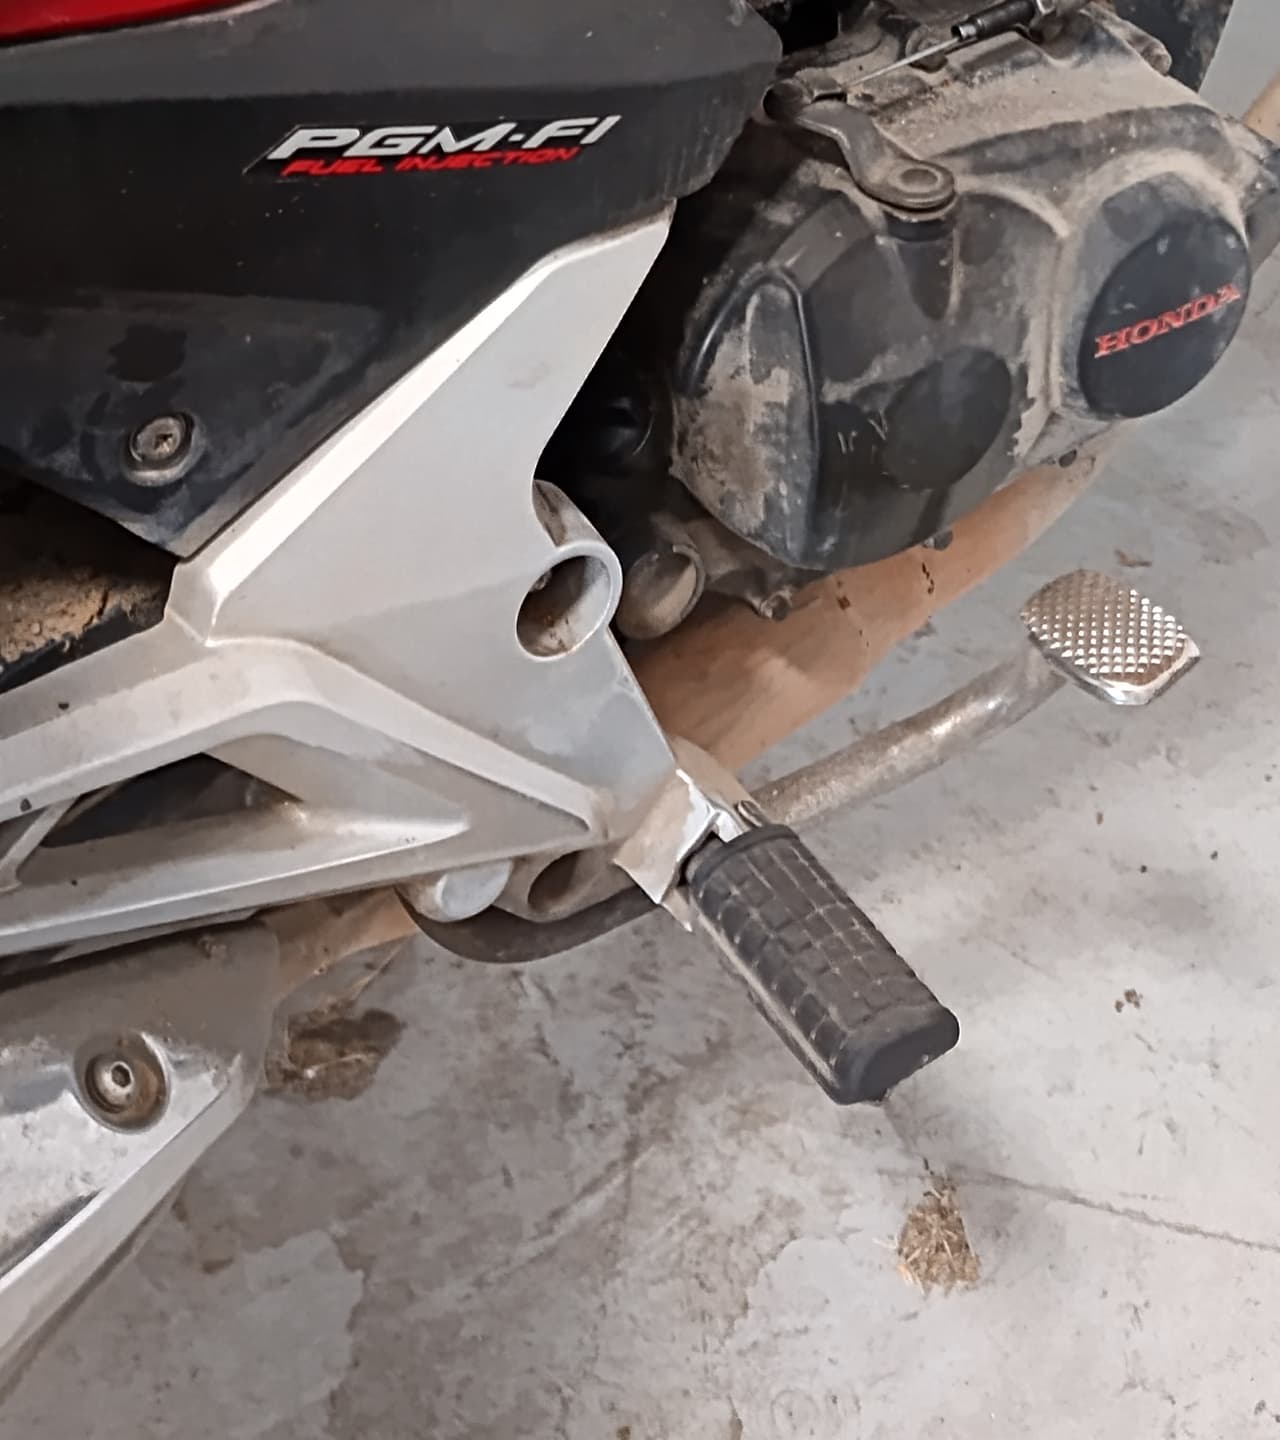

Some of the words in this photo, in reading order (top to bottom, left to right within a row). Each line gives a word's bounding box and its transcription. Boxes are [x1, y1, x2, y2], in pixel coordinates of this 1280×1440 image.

[267, 115, 622, 159] PGM-FI
[281, 159, 383, 176] FUEL
[396, 148, 578, 171] INJECTION
[1094, 283, 1241, 358] HONDA
